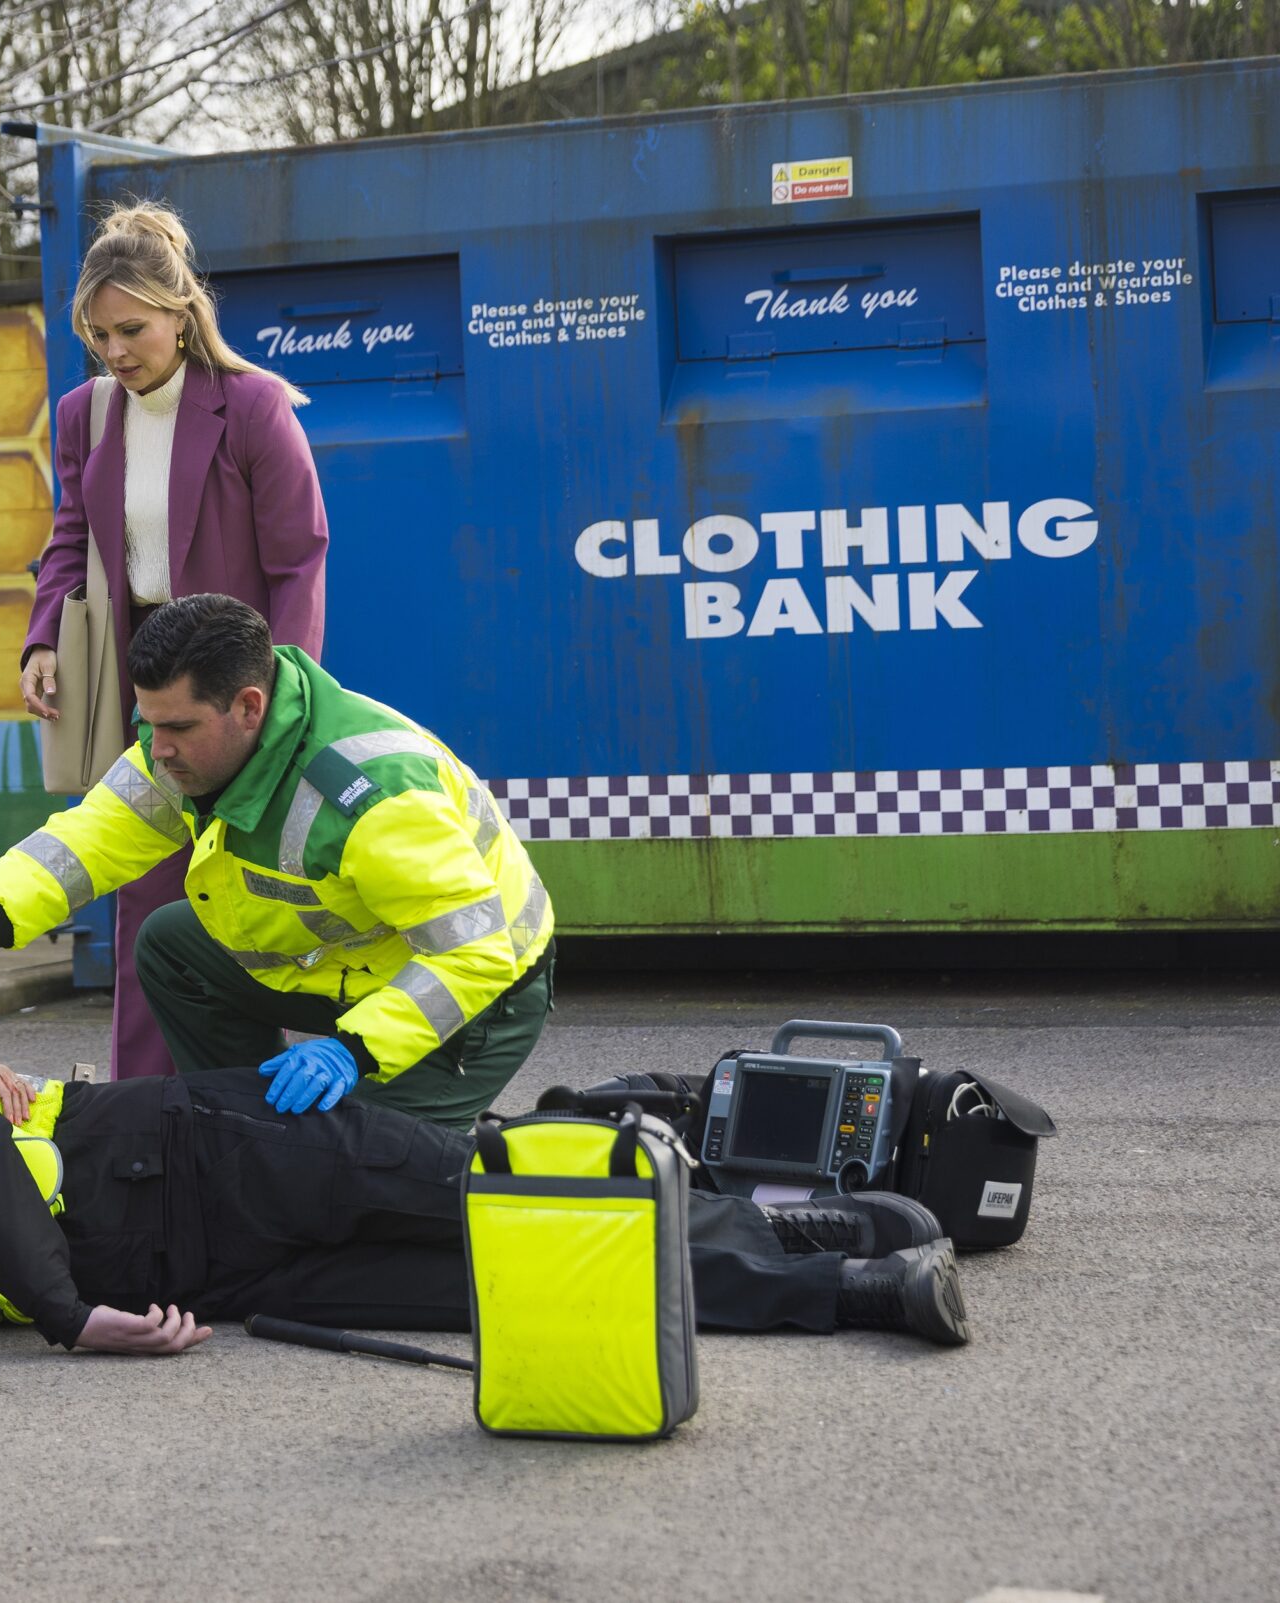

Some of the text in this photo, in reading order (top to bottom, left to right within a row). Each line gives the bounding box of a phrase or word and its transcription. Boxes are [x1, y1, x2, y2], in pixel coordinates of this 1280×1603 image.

[799, 165, 841, 176] Danger
[794, 182, 848, 195] Do not enter
[999, 257, 1187, 281] Please donate your
[995, 270, 1193, 298] Clean and Wearable
[471, 294, 639, 319] Please donate your
[744, 283, 918, 322] Thank you
[1018, 290, 1172, 312] Clothes & Shoes
[468, 307, 646, 335] Clean and Wearable
[256, 319, 414, 358] Thank you
[488, 325, 627, 348] Clothes & Shoes
[575, 498, 1098, 578] CLOTHING
[683, 570, 983, 640] BANK
[337, 775, 367, 803] AMBULANCE
[342, 780, 372, 807] PARAMEDIC
[986, 1191, 1015, 1204] LIFEPAK
